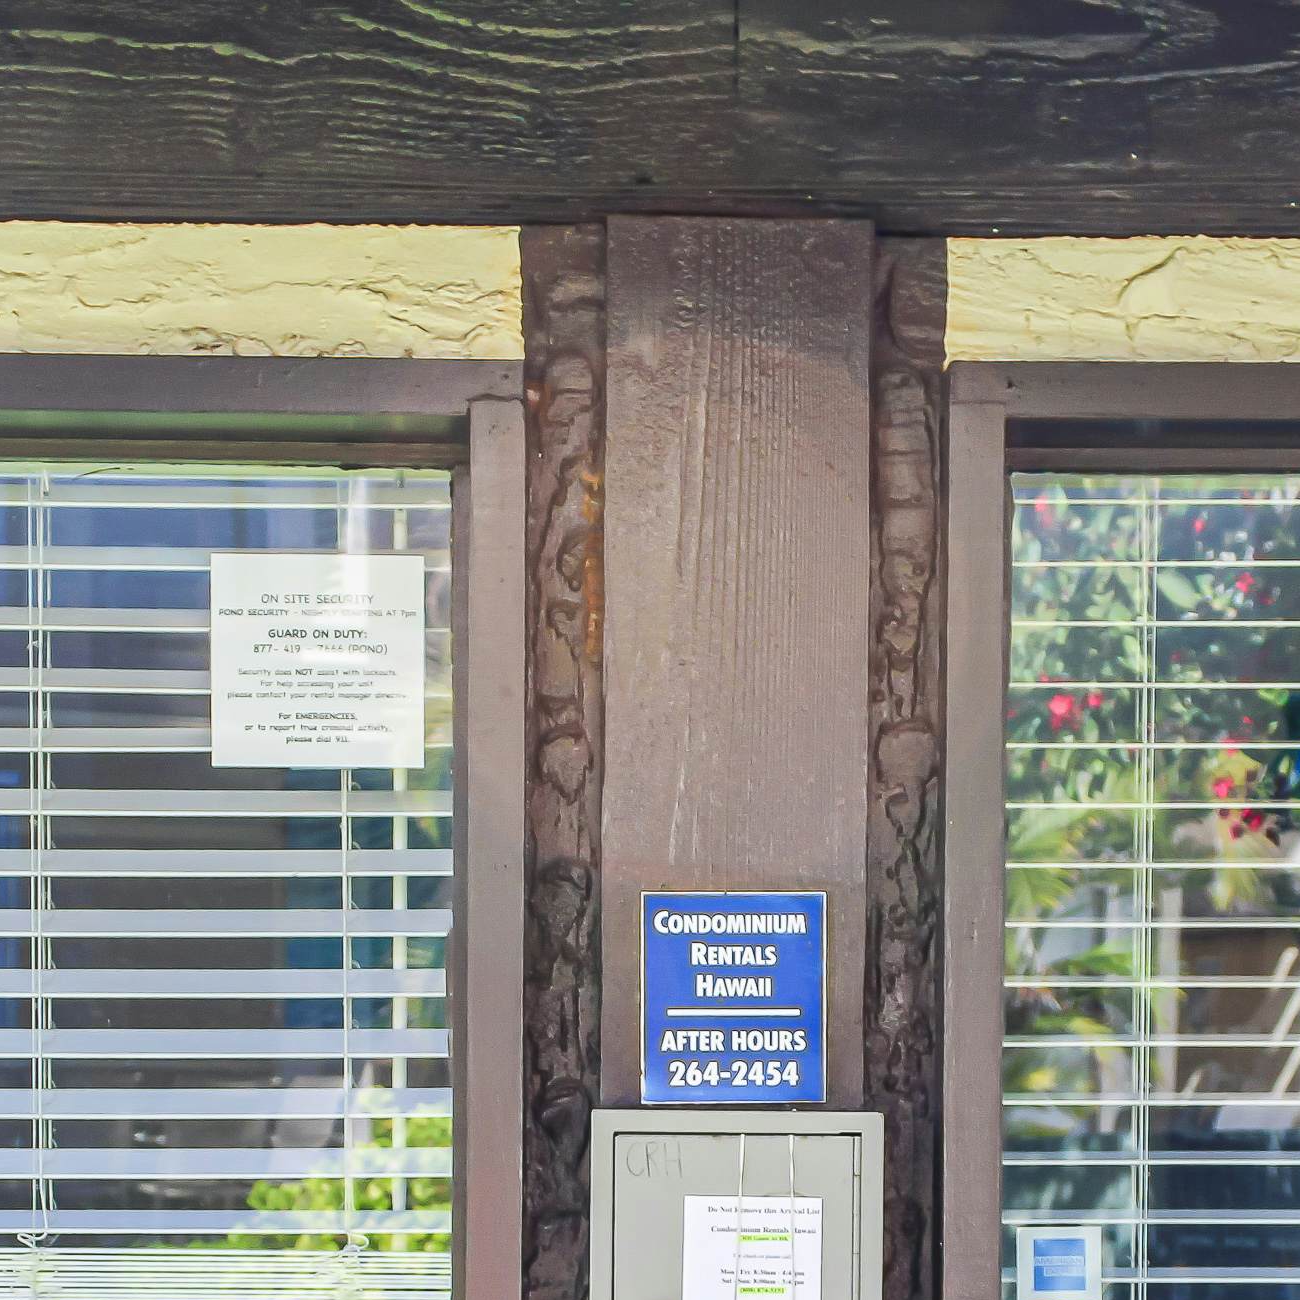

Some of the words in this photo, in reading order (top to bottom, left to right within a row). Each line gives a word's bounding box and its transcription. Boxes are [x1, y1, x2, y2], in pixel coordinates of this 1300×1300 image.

[261, 594, 279, 604] ON
[284, 594, 310, 604] SITE
[317, 594, 374, 604] SECURITY
[268, 629, 307, 639] GUARD
[313, 629, 329, 639] ON
[334, 629, 368, 639] DUTY:
[284, 644, 300, 654] 419
[348, 644, 388, 655] (PONO)
[238, 668, 271, 677] Security
[295, 668, 313, 676] NOT
[343, 668, 359, 676] with
[227, 691, 252, 699] please
[256, 691, 286, 699] contact
[290, 692, 307, 700] your
[269, 725, 296, 733] report
[286, 736, 312, 744] please
[661, 1030, 724, 1051] AFTER
[731, 1030, 807, 1051] HOURS
[668, 1061, 798, 1086] 264-2454
[626, 1140, 683, 1178] CRH
